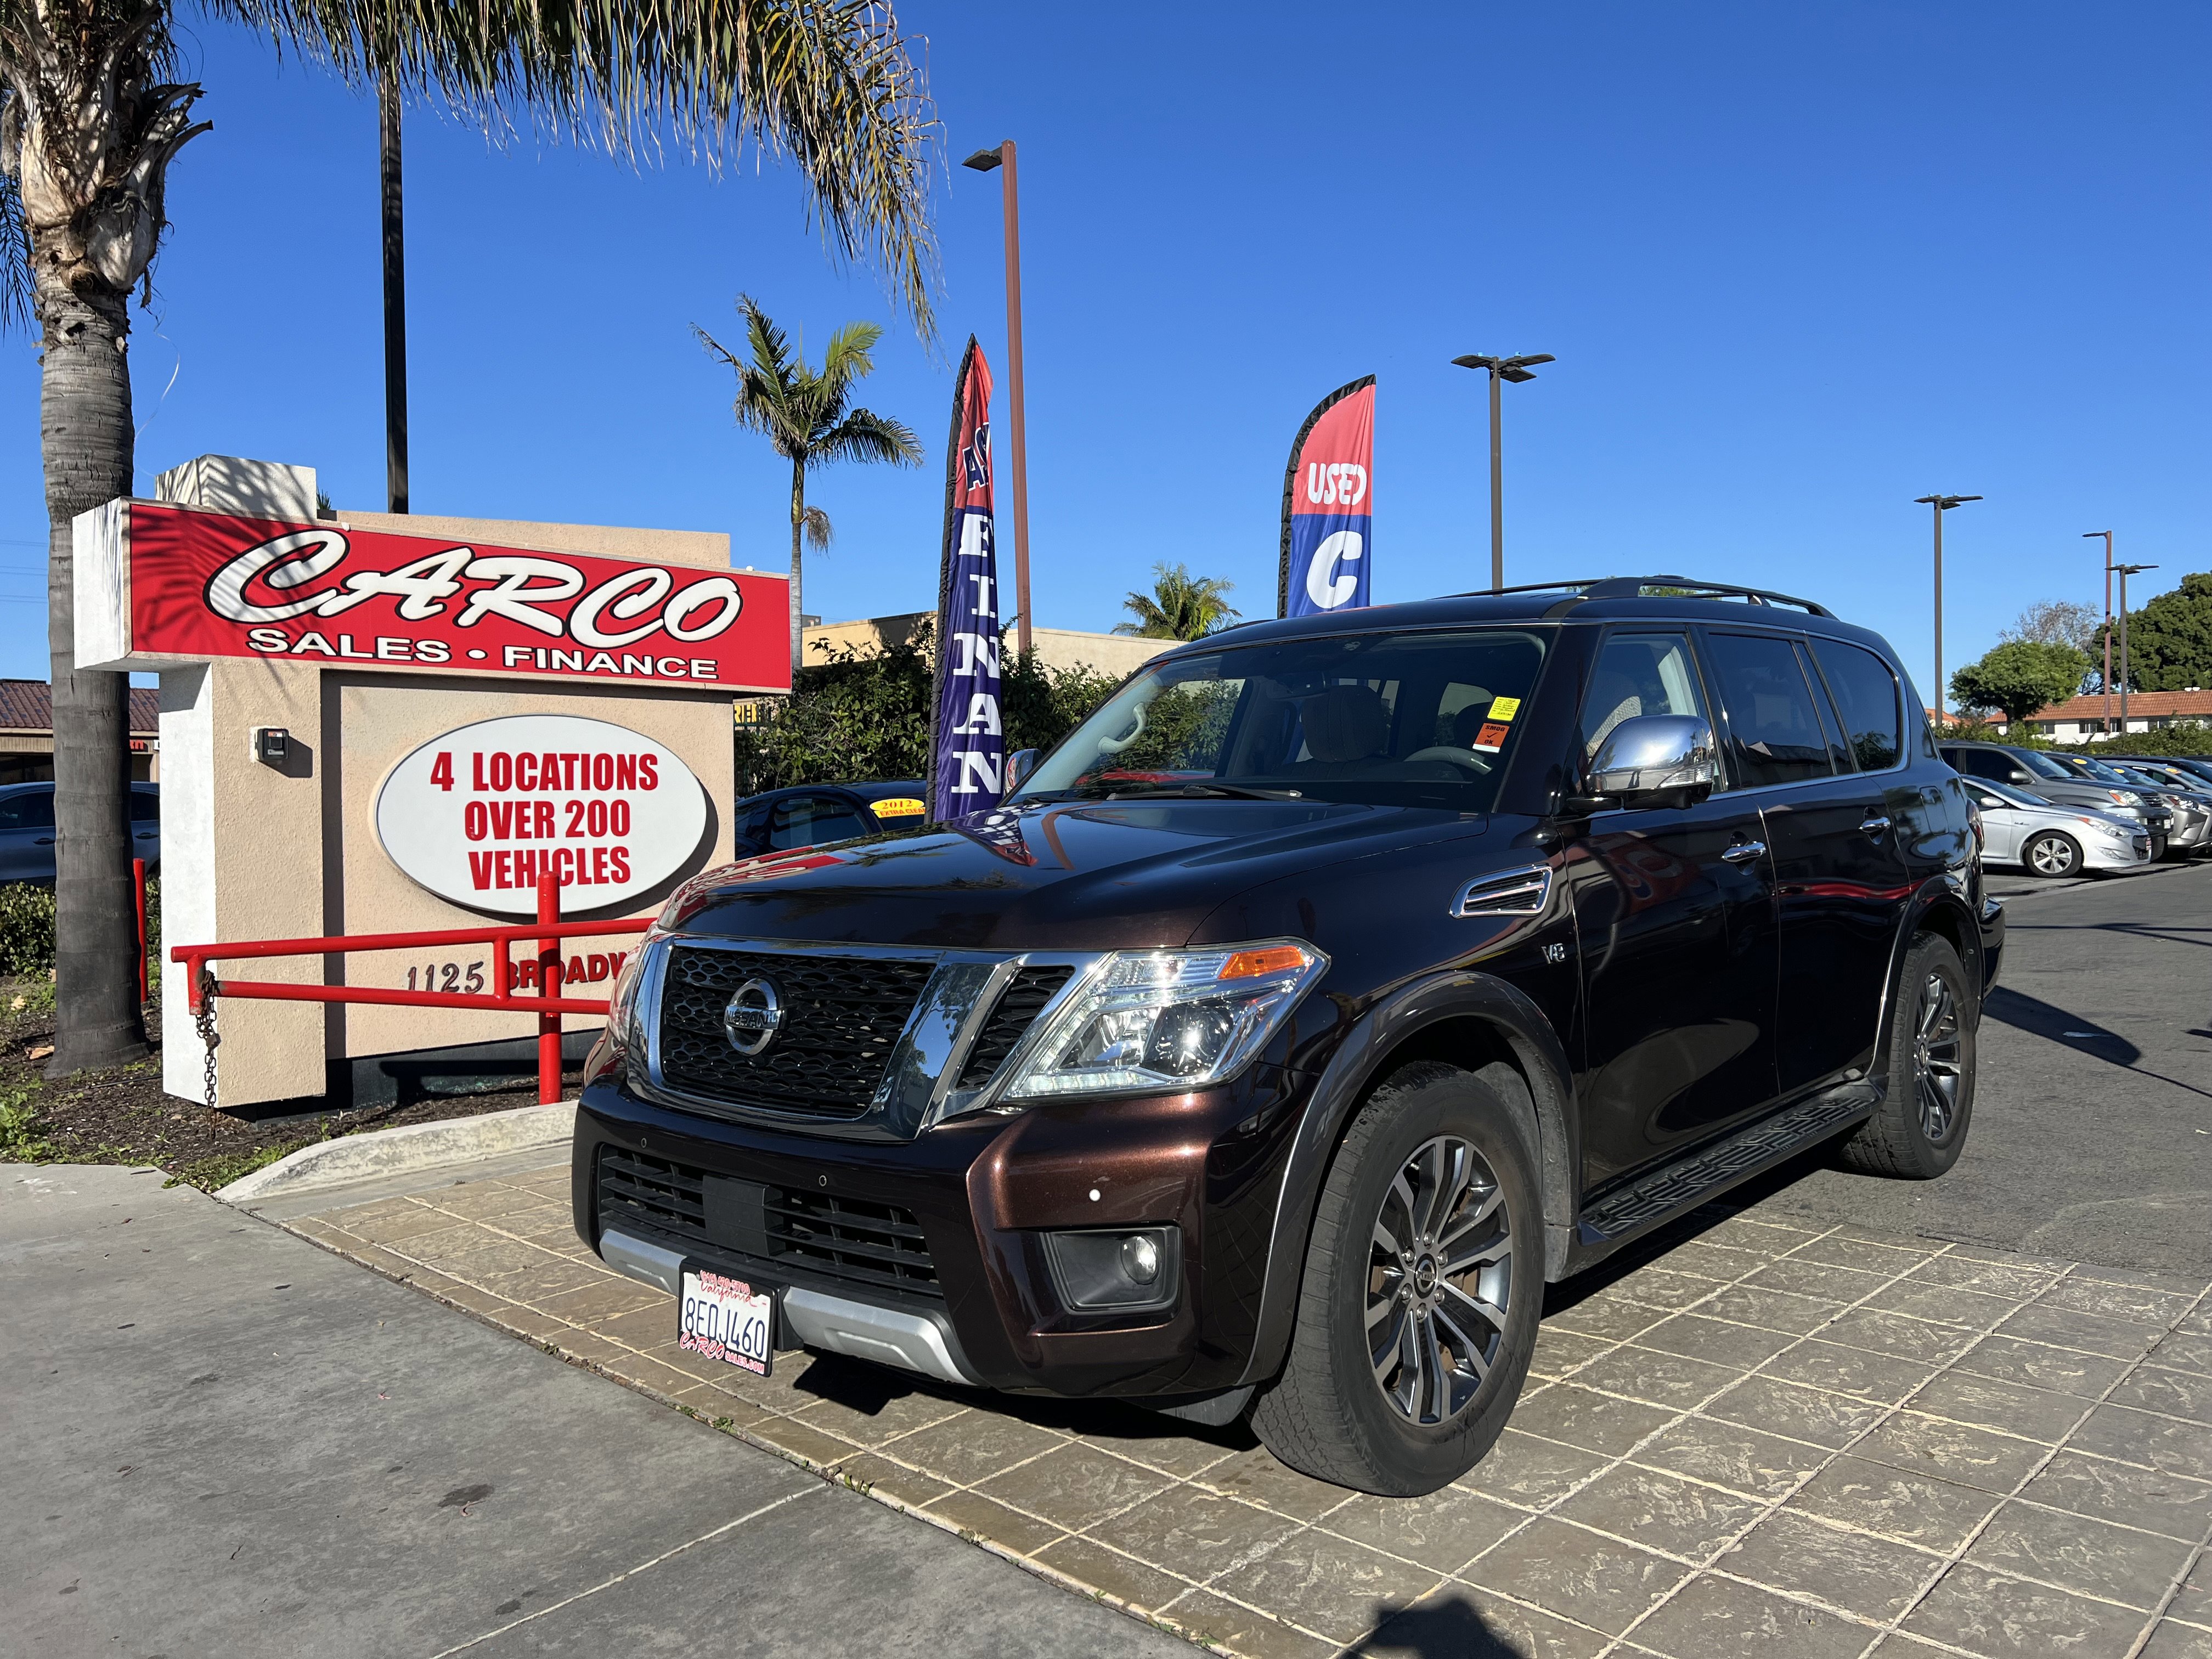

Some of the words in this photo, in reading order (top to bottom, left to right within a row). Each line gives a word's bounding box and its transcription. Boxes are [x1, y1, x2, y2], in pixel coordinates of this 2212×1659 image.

[1307, 462, 1367, 505] USED
[204, 530, 743, 648] CARCO
[247, 628, 450, 662] SALES
[503, 646, 719, 680] FINANCE
[430, 752, 454, 791] 4
[472, 752, 658, 792] LOCATIONS
[464, 800, 556, 841] OVER
[565, 799, 630, 837] 200
[879, 809, 905, 817] EXTRA
[882, 800, 913, 809] 2012
[468, 845, 630, 890] VEHICLES
[1541, 943, 1565, 964] V8
[406, 961, 484, 994] 1125
[725, 1008, 769, 1028] NISSAN
